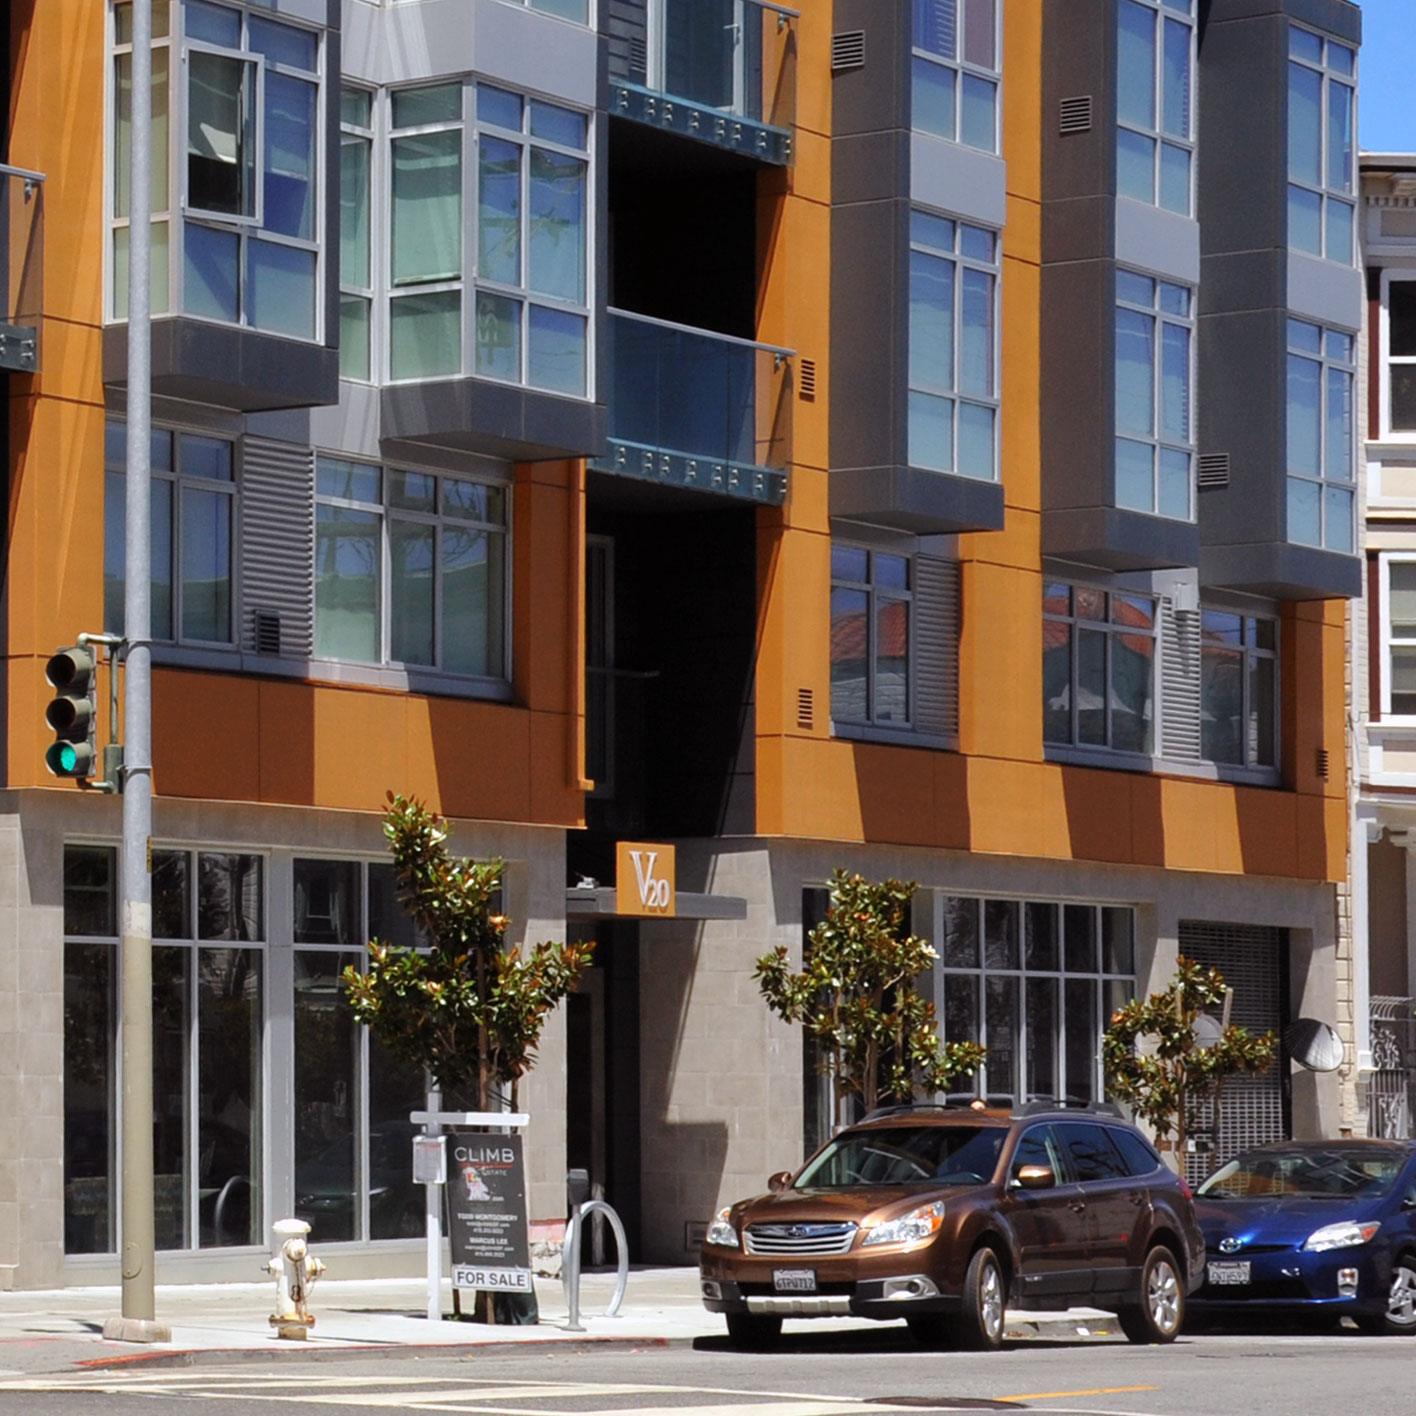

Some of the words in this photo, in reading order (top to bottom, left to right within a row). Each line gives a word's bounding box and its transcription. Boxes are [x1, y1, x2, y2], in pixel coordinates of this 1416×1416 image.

[454, 1146, 515, 1163] CLIMB
[496, 1238, 508, 1246] LEE
[457, 1271, 485, 1285] FOR
[489, 1274, 526, 1287] SALE
